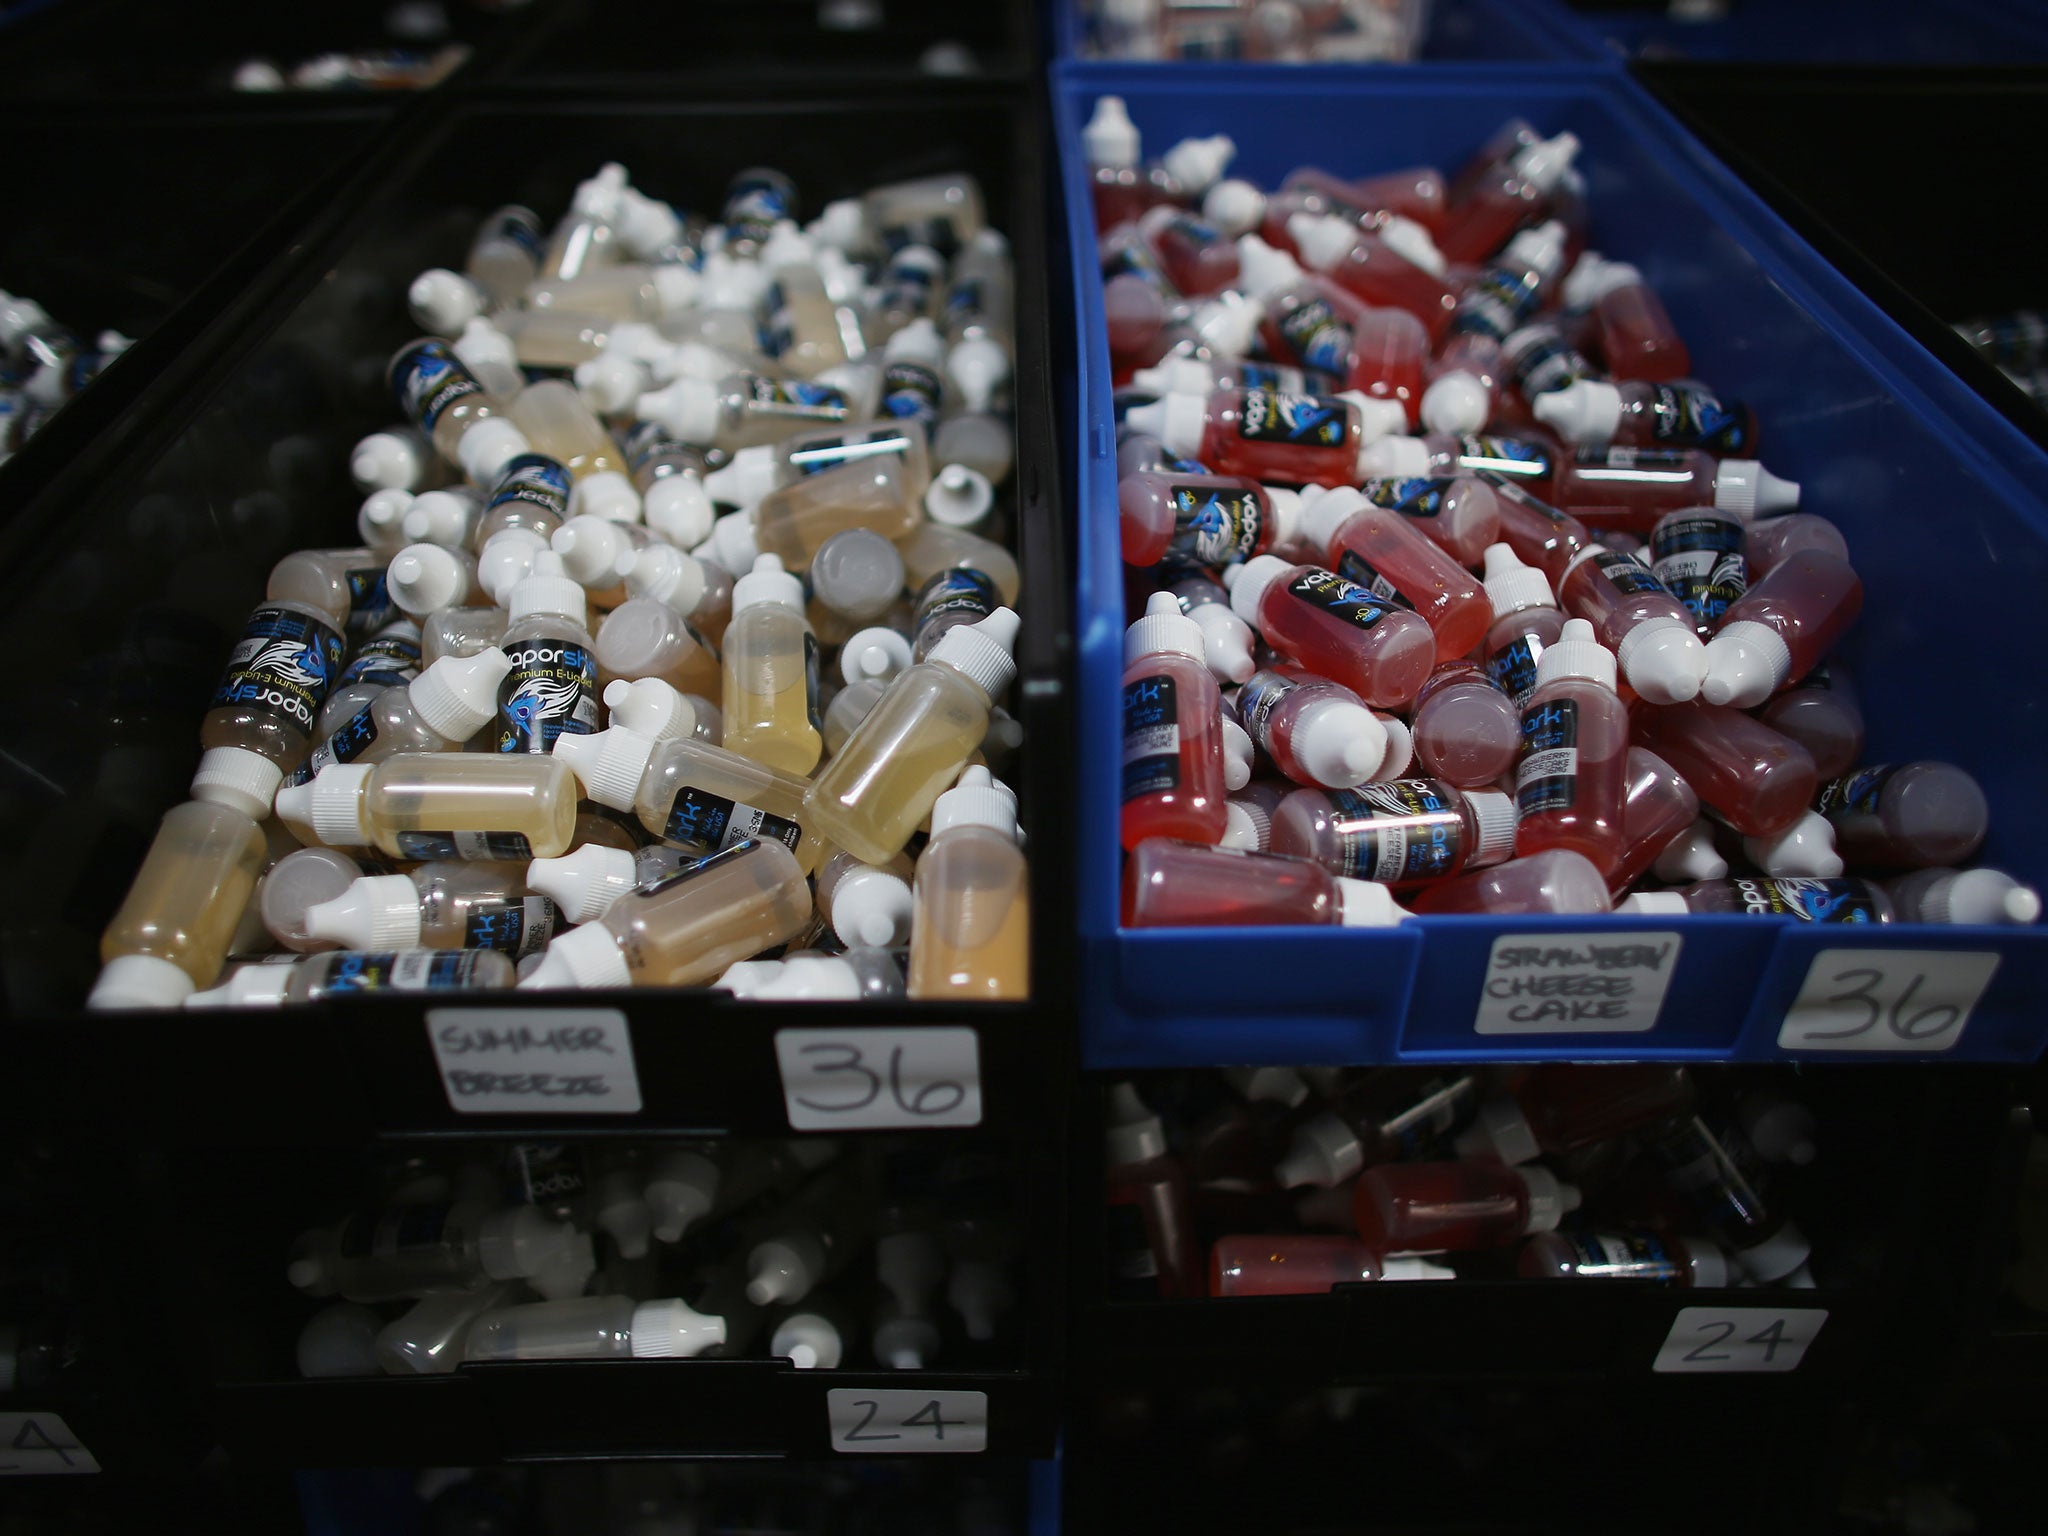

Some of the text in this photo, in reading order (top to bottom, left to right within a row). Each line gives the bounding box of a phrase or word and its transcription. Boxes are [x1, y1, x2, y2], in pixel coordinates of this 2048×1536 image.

[274, 675, 317, 707] Premium
[1523, 707, 1562, 734] ark
[675, 802, 702, 841] ark
[1486, 973, 1636, 999] CHEESE
[1803, 968, 1960, 1040] 36
[1507, 1000, 1629, 1022] CAKE
[440, 1025, 615, 1055] SUMMER
[797, 1043, 966, 1116] 36
[1682, 1318, 1794, 1362] 24
[843, 1400, 967, 1442] 24
[0, 1418, 78, 1470] 4
